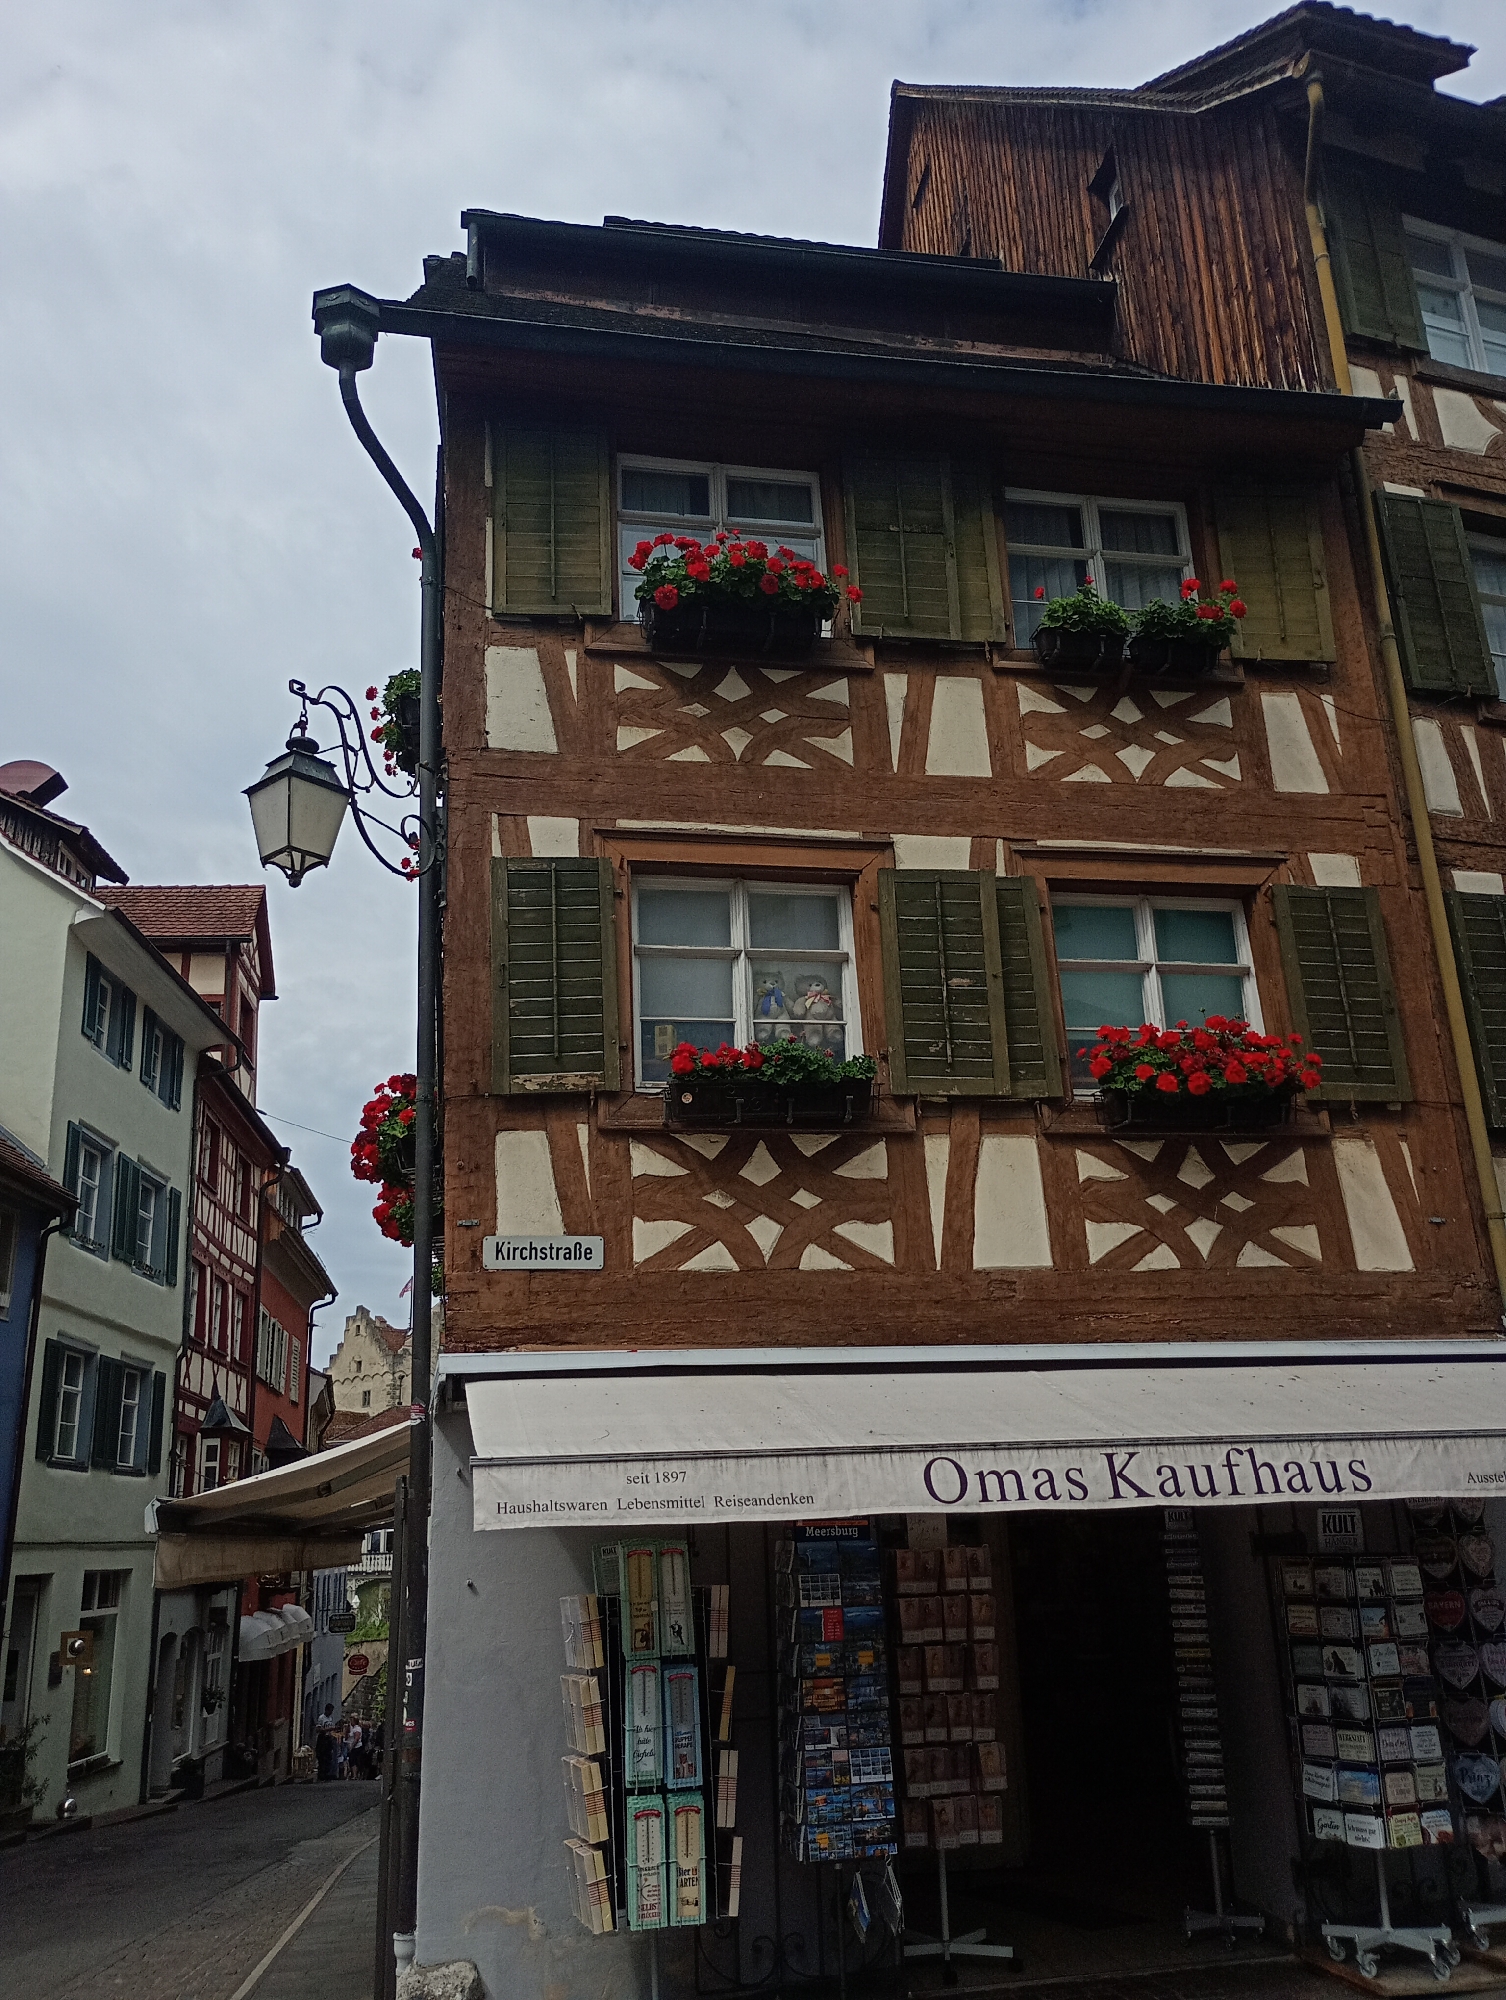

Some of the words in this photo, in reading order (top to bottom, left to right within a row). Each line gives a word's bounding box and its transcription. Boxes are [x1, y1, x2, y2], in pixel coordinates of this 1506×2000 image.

[495, 1241, 593, 1261] Kirchstraße
[626, 1471, 650, 1485] seit
[655, 1470, 687, 1484] 1897
[923, 1456, 1090, 1505] Omas
[1099, 1446, 1374, 1500] Kaufhaus
[496, 1497, 608, 1515] Haushaltswaren
[617, 1494, 705, 1511] Lebensmittel
[714, 1492, 815, 1509] Reiseandenken
[805, 1525, 859, 1538] Meersburg
[1322, 1515, 1356, 1533] KULT
